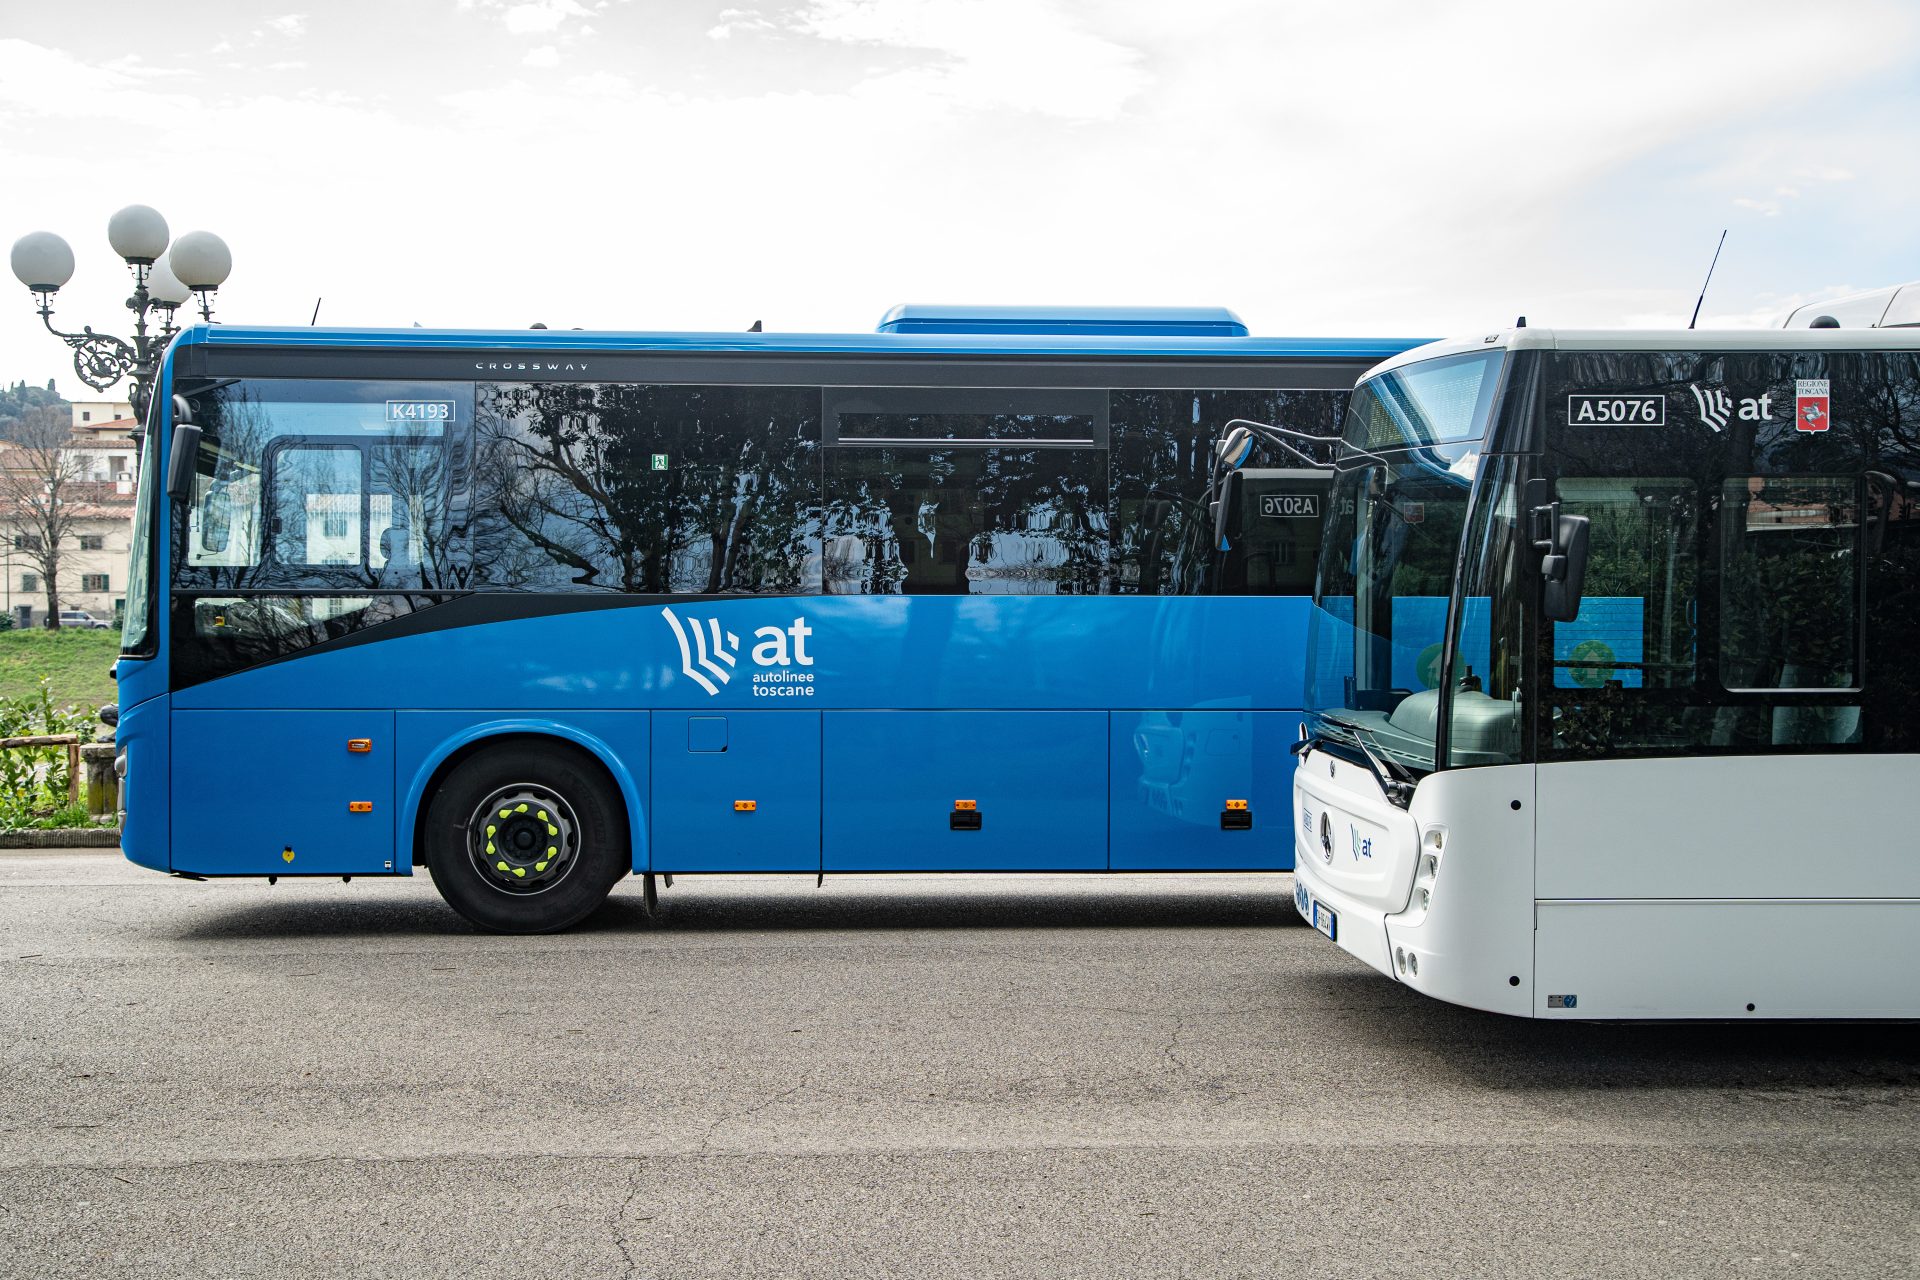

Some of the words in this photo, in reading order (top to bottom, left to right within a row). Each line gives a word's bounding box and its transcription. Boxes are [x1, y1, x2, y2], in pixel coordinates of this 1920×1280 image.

[475, 362, 588, 371] CROSSWAY
[1797, 380, 1829, 388] REGIONE
[393, 403, 449, 419] K4193
[1577, 400, 1656, 421] A5076
[1738, 393, 1773, 421] at
[751, 616, 814, 666] at
[752, 670, 815, 683] autolinee
[752, 684, 815, 697] toscane
[1362, 837, 1372, 858] at
